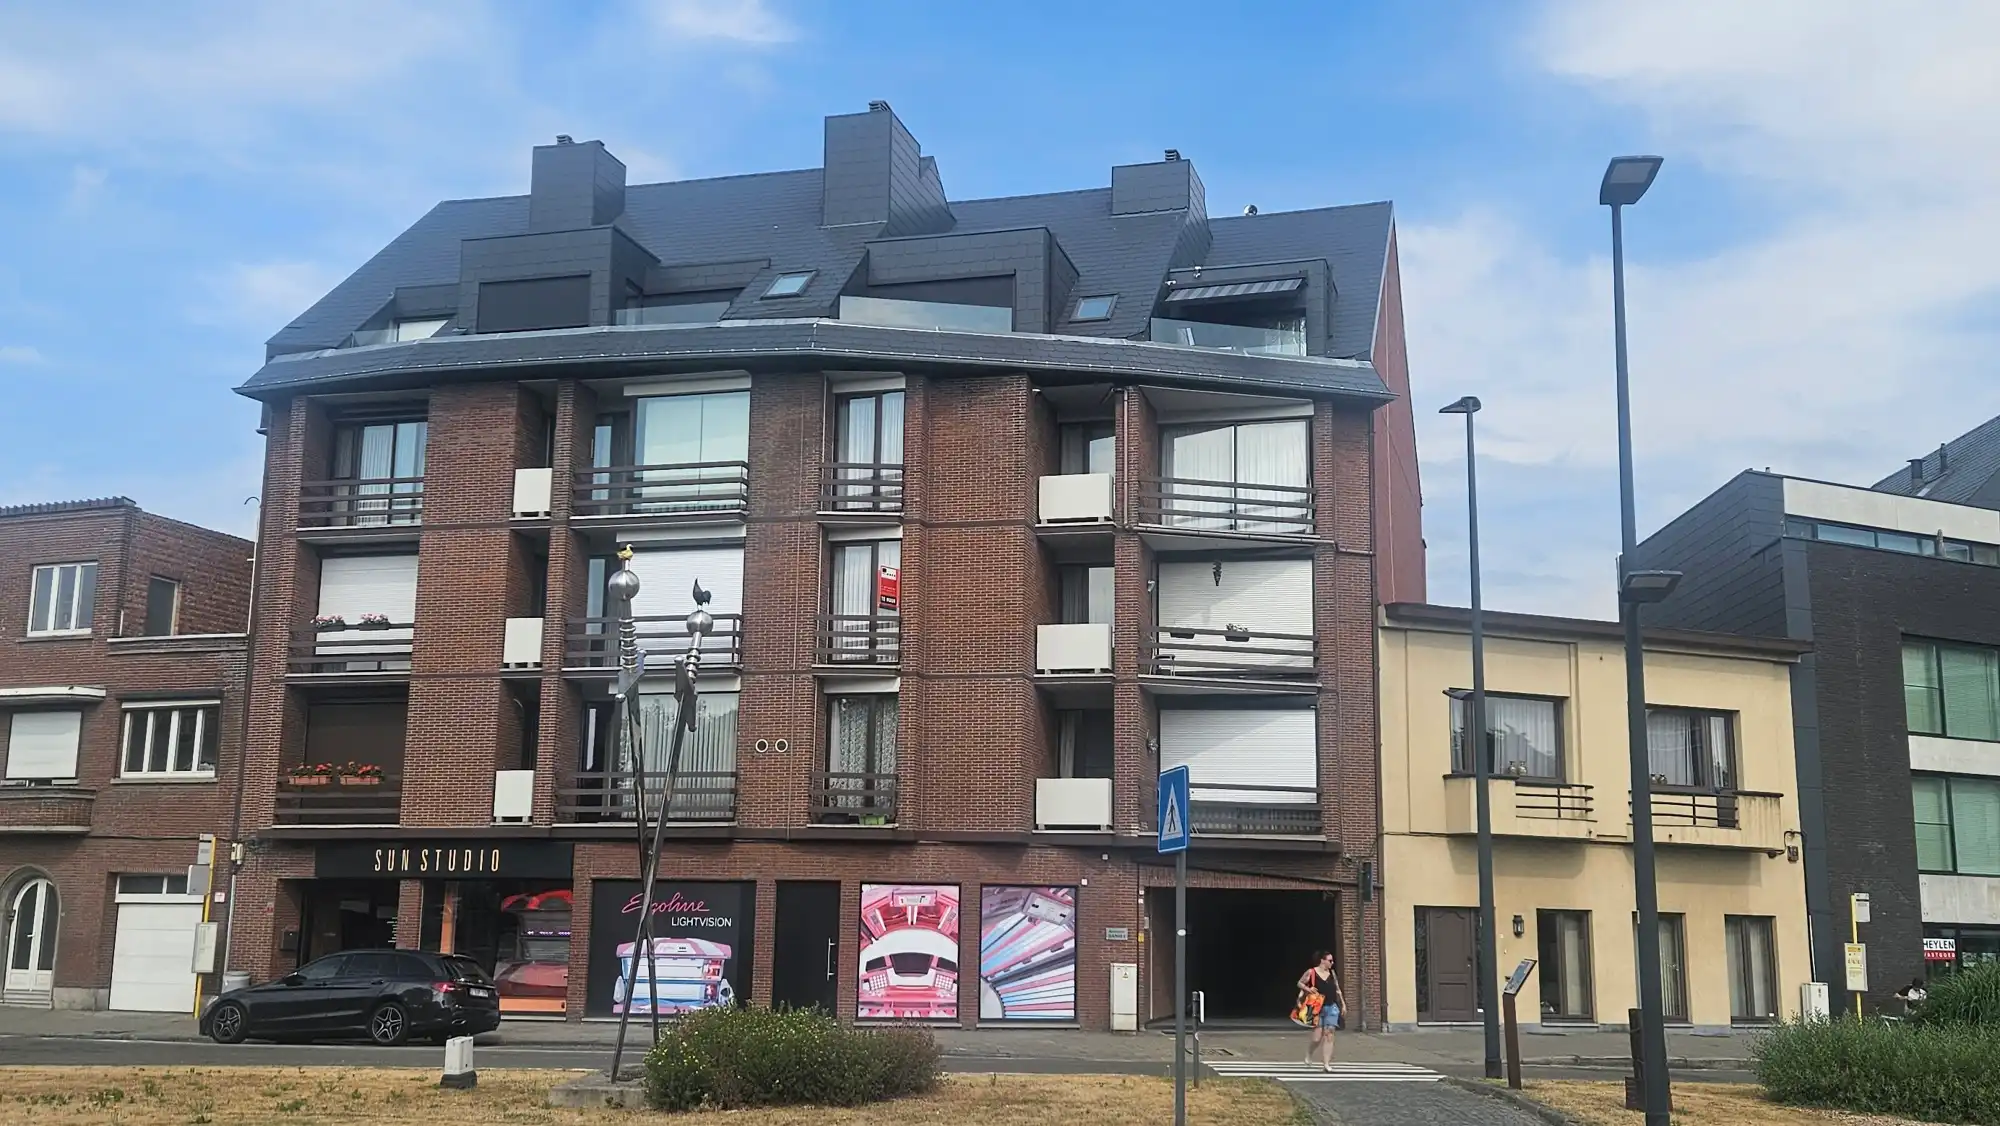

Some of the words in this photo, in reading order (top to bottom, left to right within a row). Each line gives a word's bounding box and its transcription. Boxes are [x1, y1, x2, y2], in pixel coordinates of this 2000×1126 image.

[374, 849, 410, 872] SUN
[420, 849, 500, 872] STUDIO
[621, 892, 710, 915] Egoline
[671, 916, 732, 928] LIGHTVISION
[1923, 940, 1955, 950] HEYLEN
